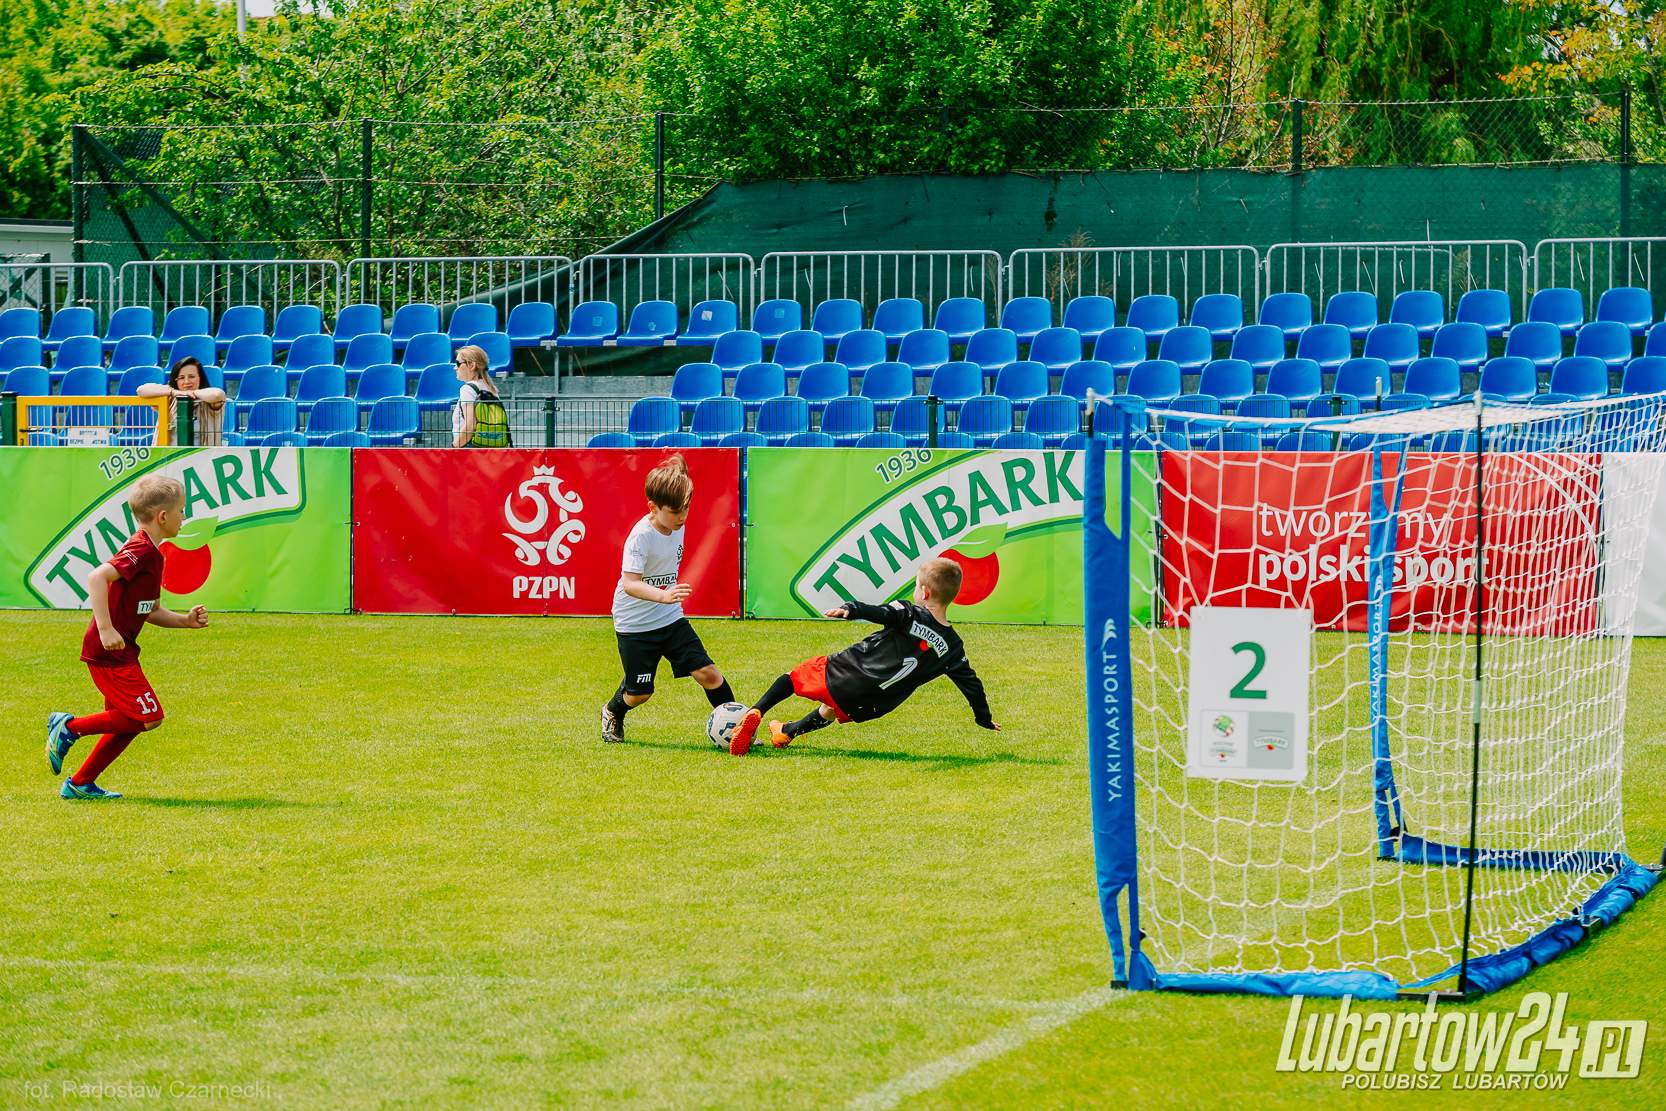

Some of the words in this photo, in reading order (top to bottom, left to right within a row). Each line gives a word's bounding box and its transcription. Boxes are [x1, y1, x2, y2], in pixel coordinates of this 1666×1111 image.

[99, 447, 151, 479] 1936
[876, 448, 931, 483] 1936
[46, 449, 288, 602] TYMARK
[813, 450, 1084, 602] TYMBARK
[1259, 503, 1450, 545] tworzmy
[512, 575, 576, 599] PZPN
[1259, 545, 1371, 588] polski
[913, 623, 947, 654] TYMBARK
[1230, 641, 1268, 700] 2
[137, 691, 158, 715] 15
[1102, 651, 1123, 802] YAKIMASPORT
